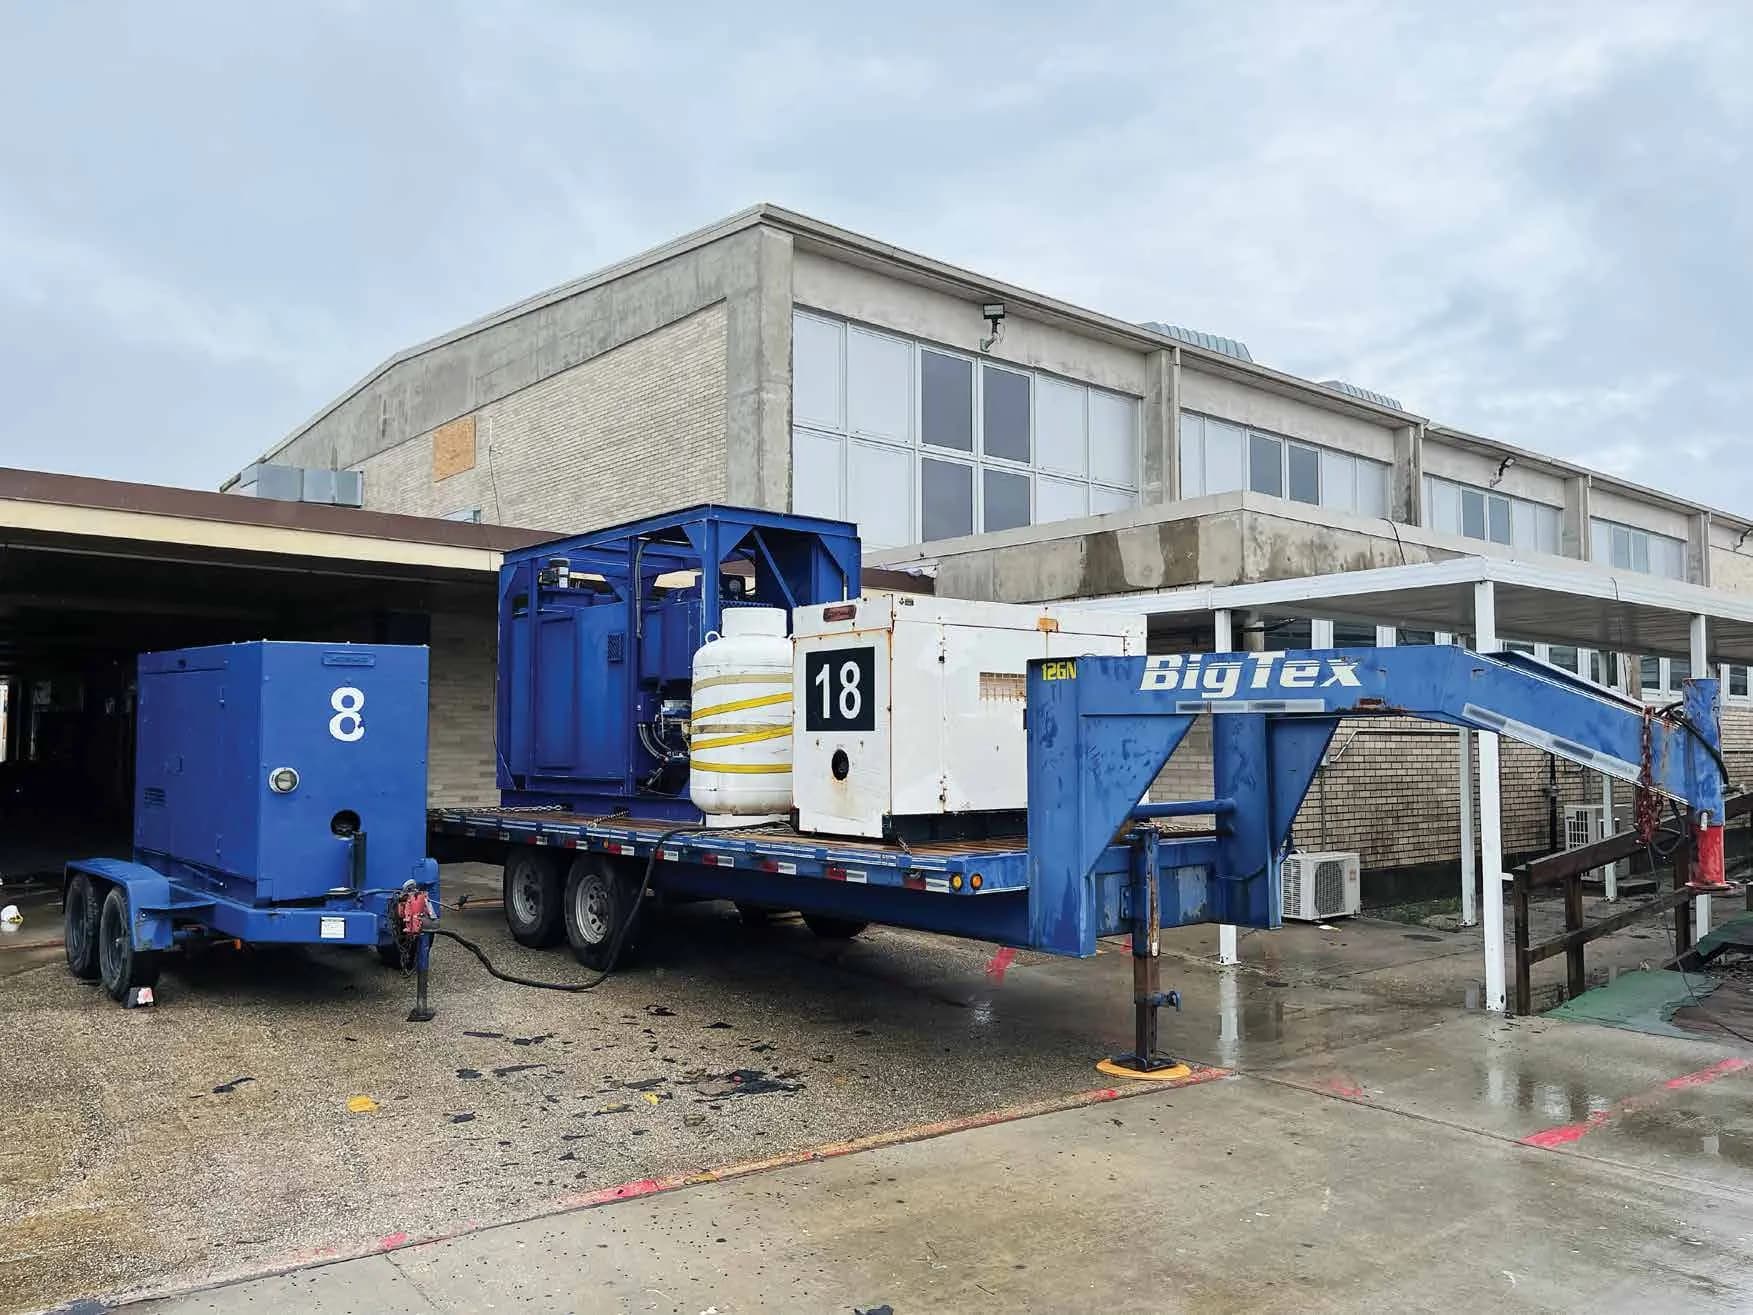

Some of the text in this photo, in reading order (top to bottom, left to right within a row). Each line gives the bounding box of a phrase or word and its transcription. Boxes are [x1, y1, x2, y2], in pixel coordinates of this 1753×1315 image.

[815, 661, 862, 719] 18
[1041, 661, 1077, 681] 12GN
[329, 687, 365, 742] 8
